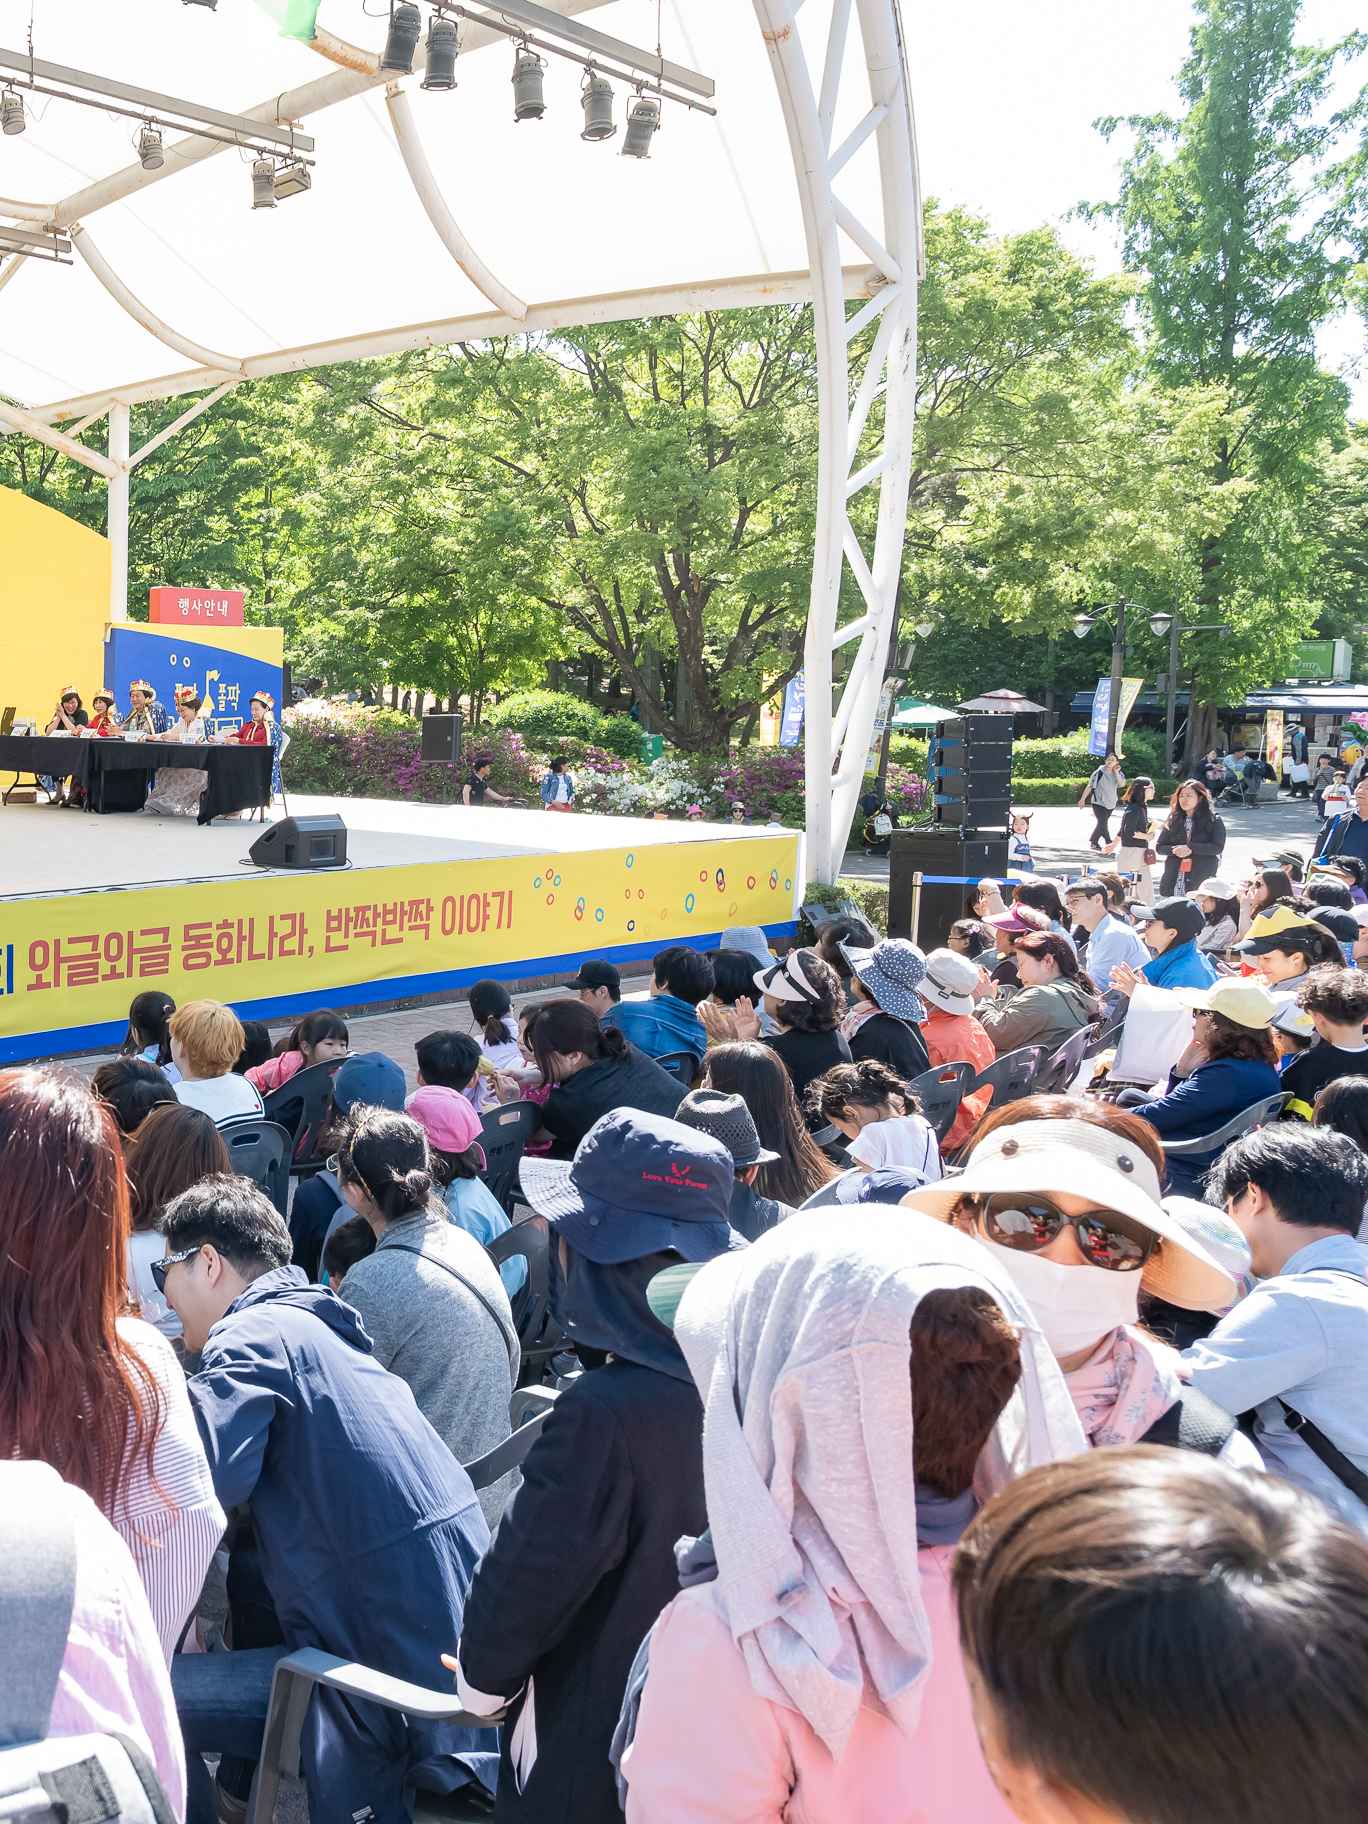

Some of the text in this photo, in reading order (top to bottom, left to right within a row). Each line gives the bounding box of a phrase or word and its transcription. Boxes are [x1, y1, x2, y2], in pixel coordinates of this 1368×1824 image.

[177, 597, 229, 618] 행사안내
[218, 683, 240, 711] 폴짝
[26, 926, 172, 992] 와글와글
[181, 911, 315, 972] 동화나라,
[324, 898, 434, 954] 반짝반짝
[441, 890, 514, 937] 이야기
[642, 1171, 708, 1190] Love Your Forest
